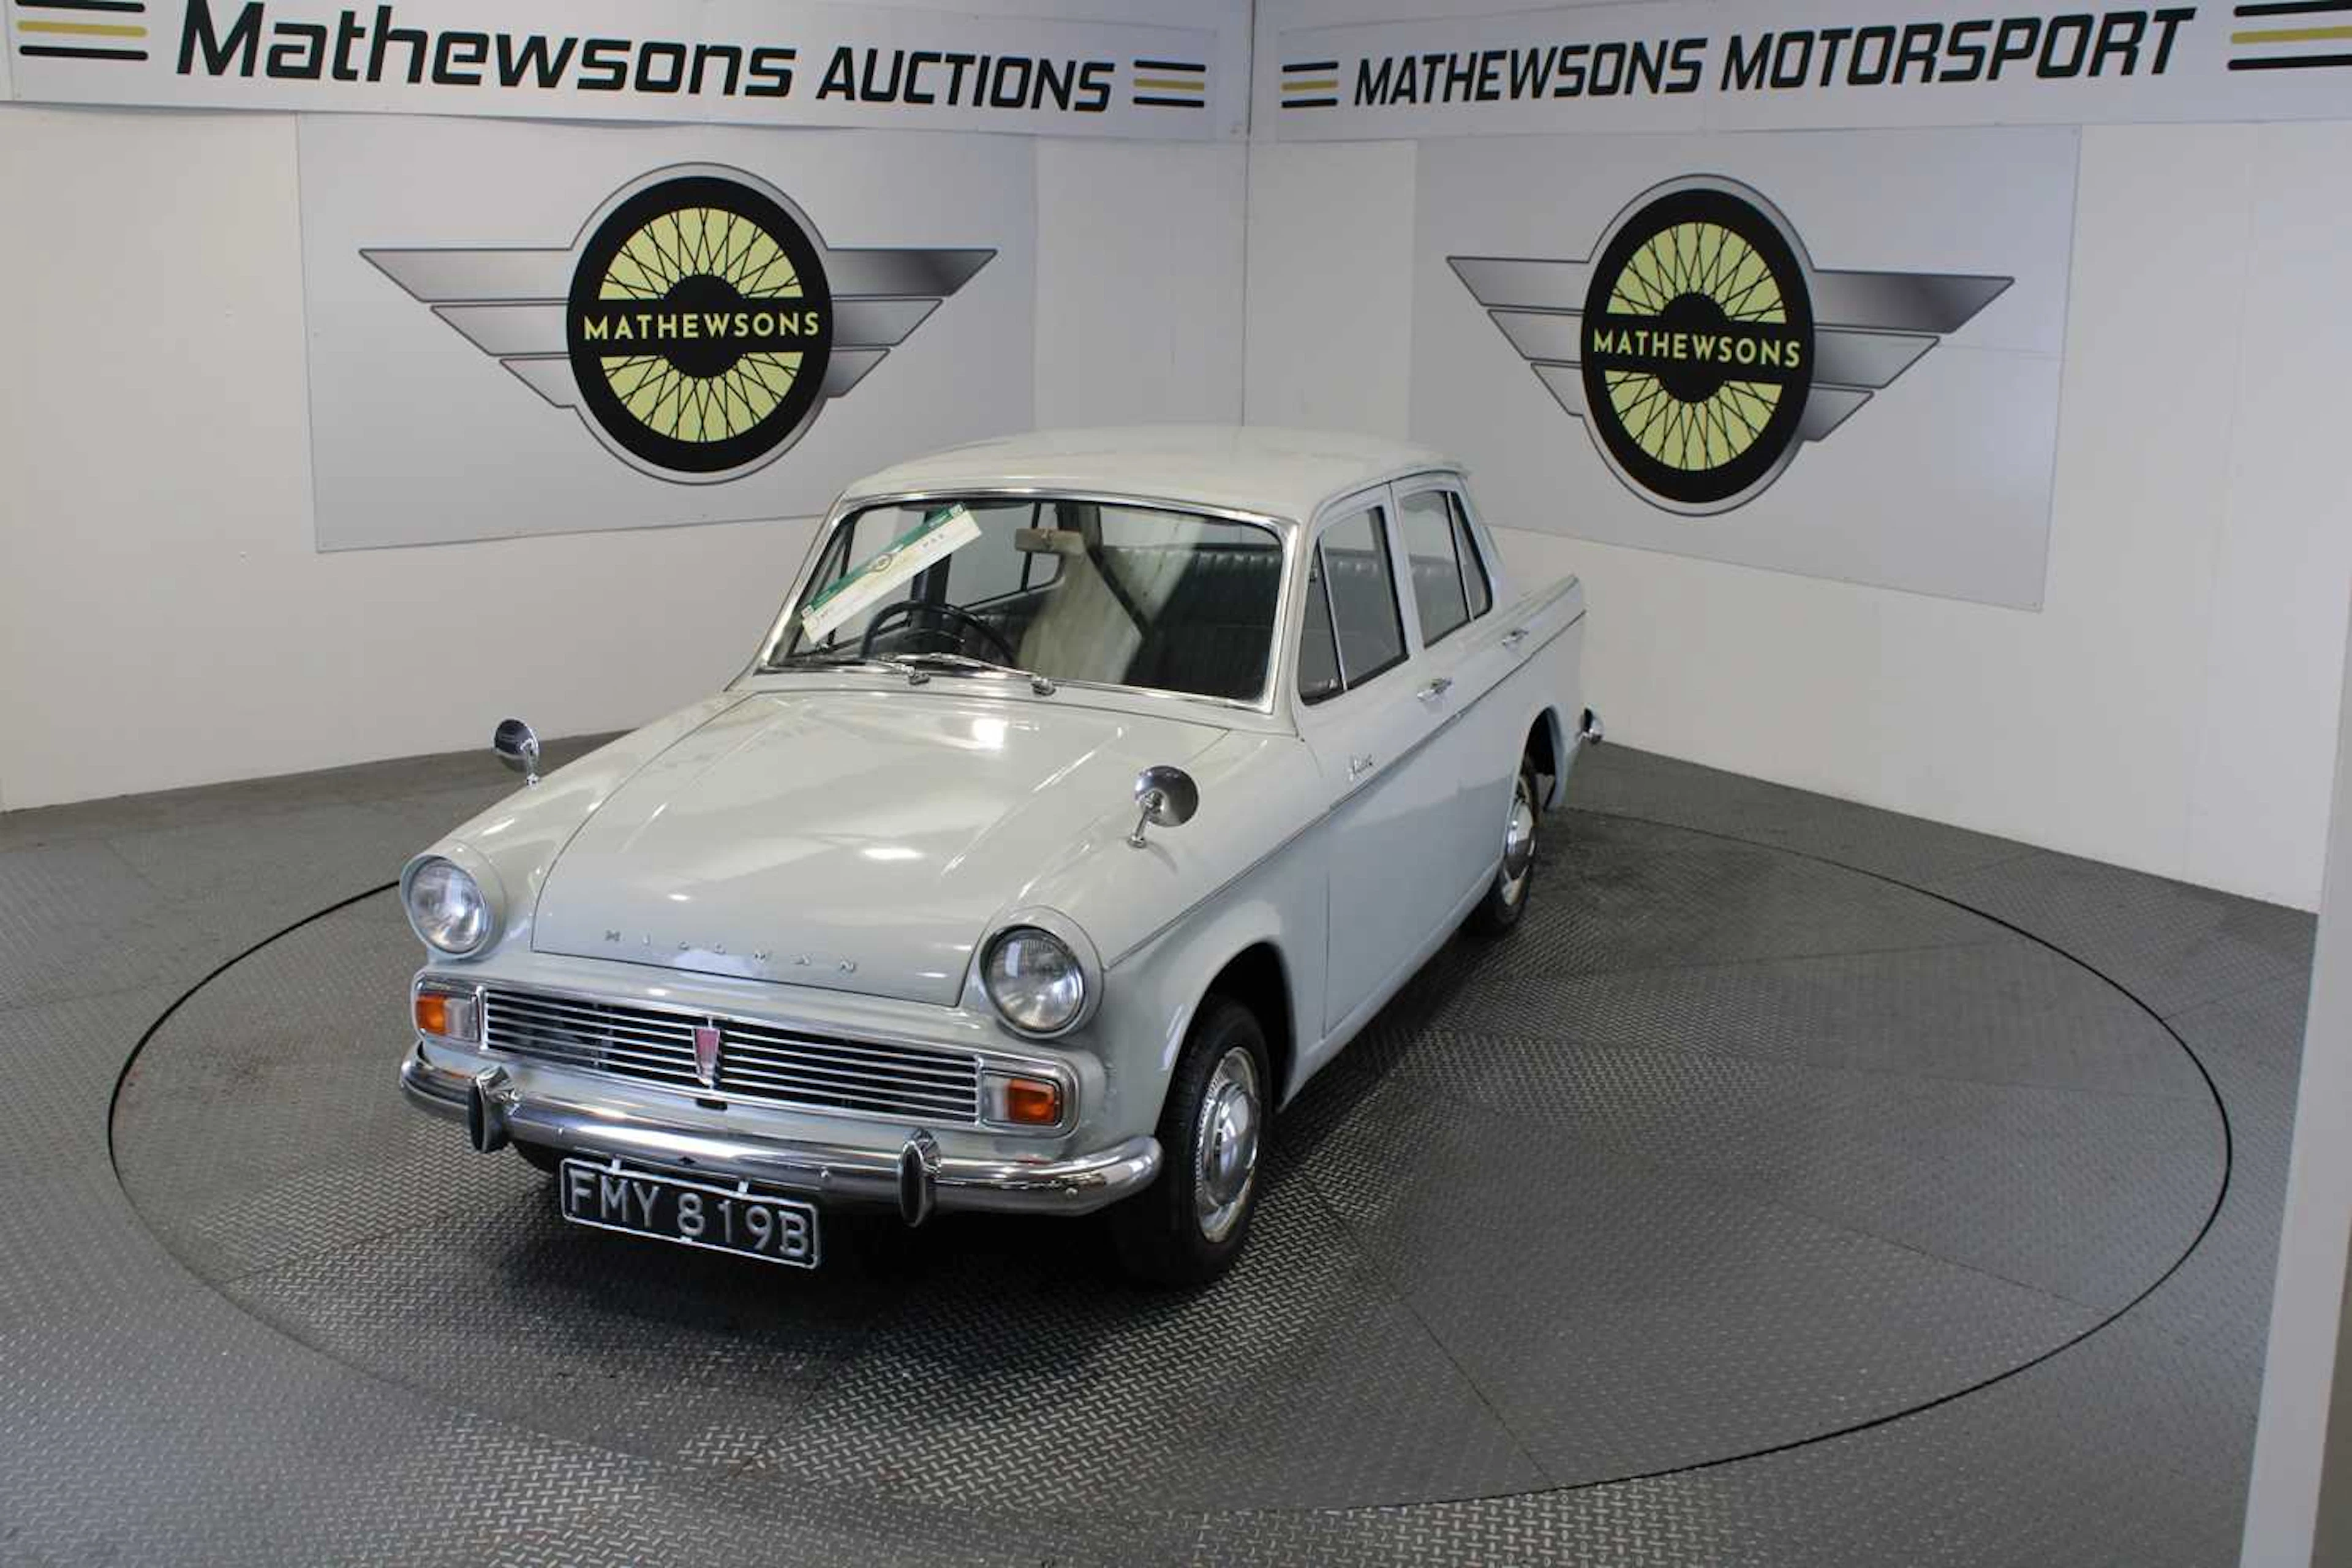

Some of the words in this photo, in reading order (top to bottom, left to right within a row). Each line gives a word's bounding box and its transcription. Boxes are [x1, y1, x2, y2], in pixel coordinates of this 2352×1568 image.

[177, 0, 796, 98] Mathewsons
[815, 46, 1115, 112] AUCTIONS
[1354, 37, 1708, 106] MATHEWSONS
[1720, 7, 2198, 92] MOTORSPORT
[583, 311, 820, 341] MATHEWSONS
[1593, 327, 1801, 369] MATHEWSONS
[567, 1167, 660, 1227] FMY
[676, 1191, 809, 1257] 819B
